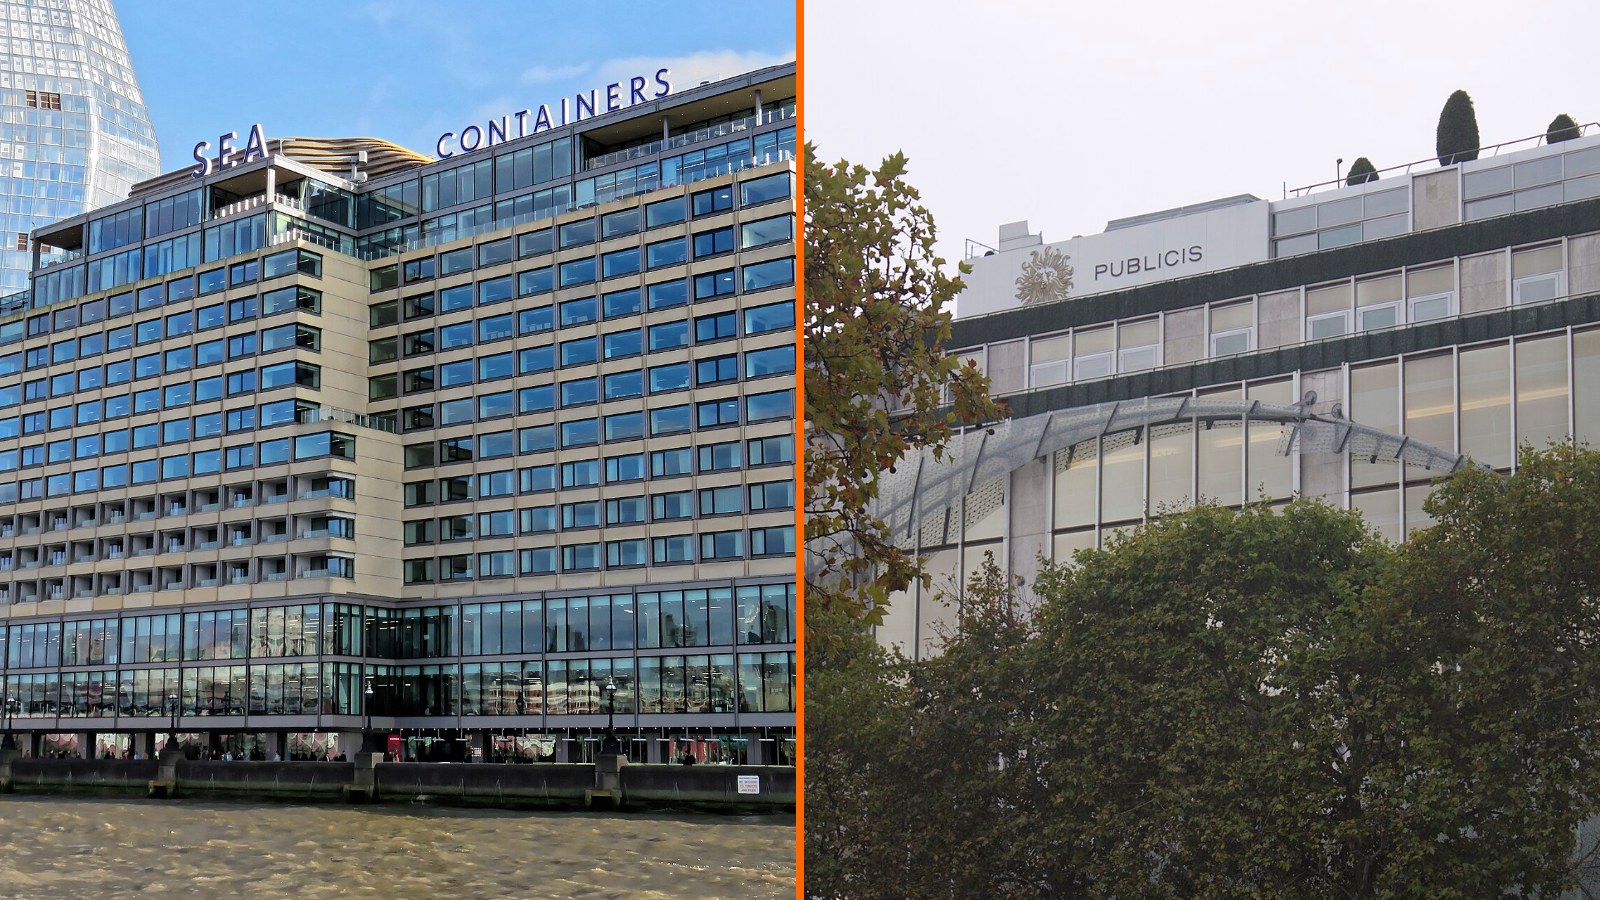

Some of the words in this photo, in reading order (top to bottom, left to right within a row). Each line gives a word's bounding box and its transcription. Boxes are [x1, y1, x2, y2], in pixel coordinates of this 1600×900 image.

[191, 123, 270, 179] SEA
[436, 68, 675, 159] CONTAINERS
[1094, 245, 1203, 281] PUBLICIS
